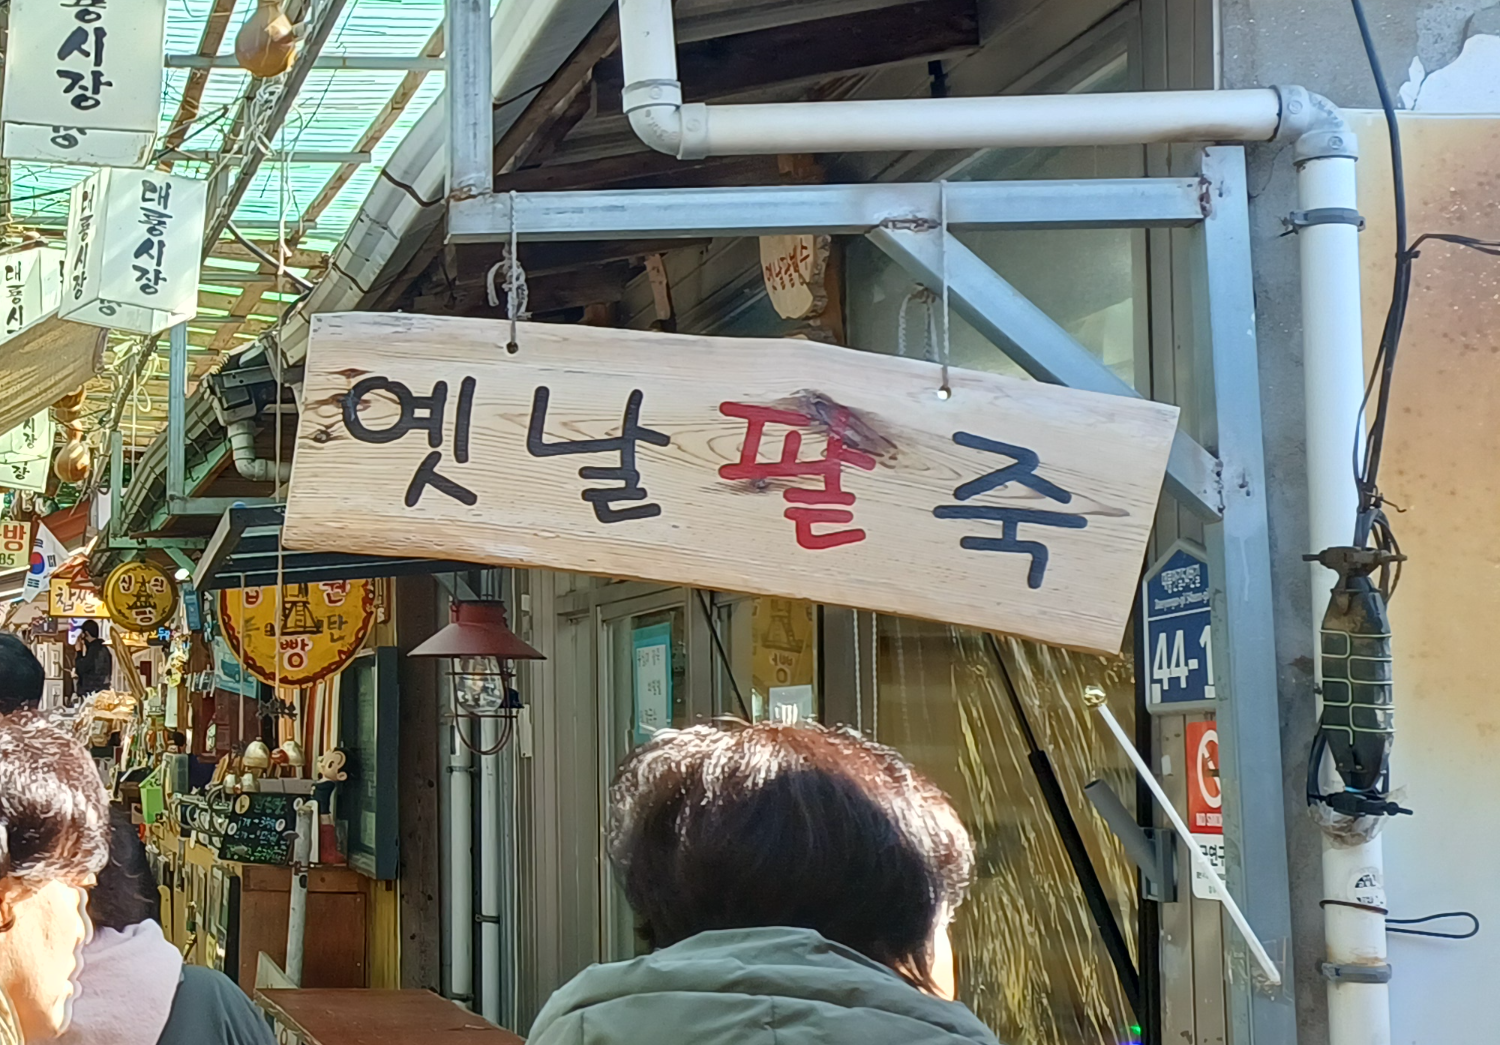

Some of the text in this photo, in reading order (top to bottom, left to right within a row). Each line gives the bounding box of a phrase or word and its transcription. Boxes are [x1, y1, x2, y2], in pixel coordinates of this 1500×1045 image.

[72, 184, 96, 300] 대룡시장
[131, 179, 173, 295] 대룡시장
[4, 260, 26, 335] 대룡시
